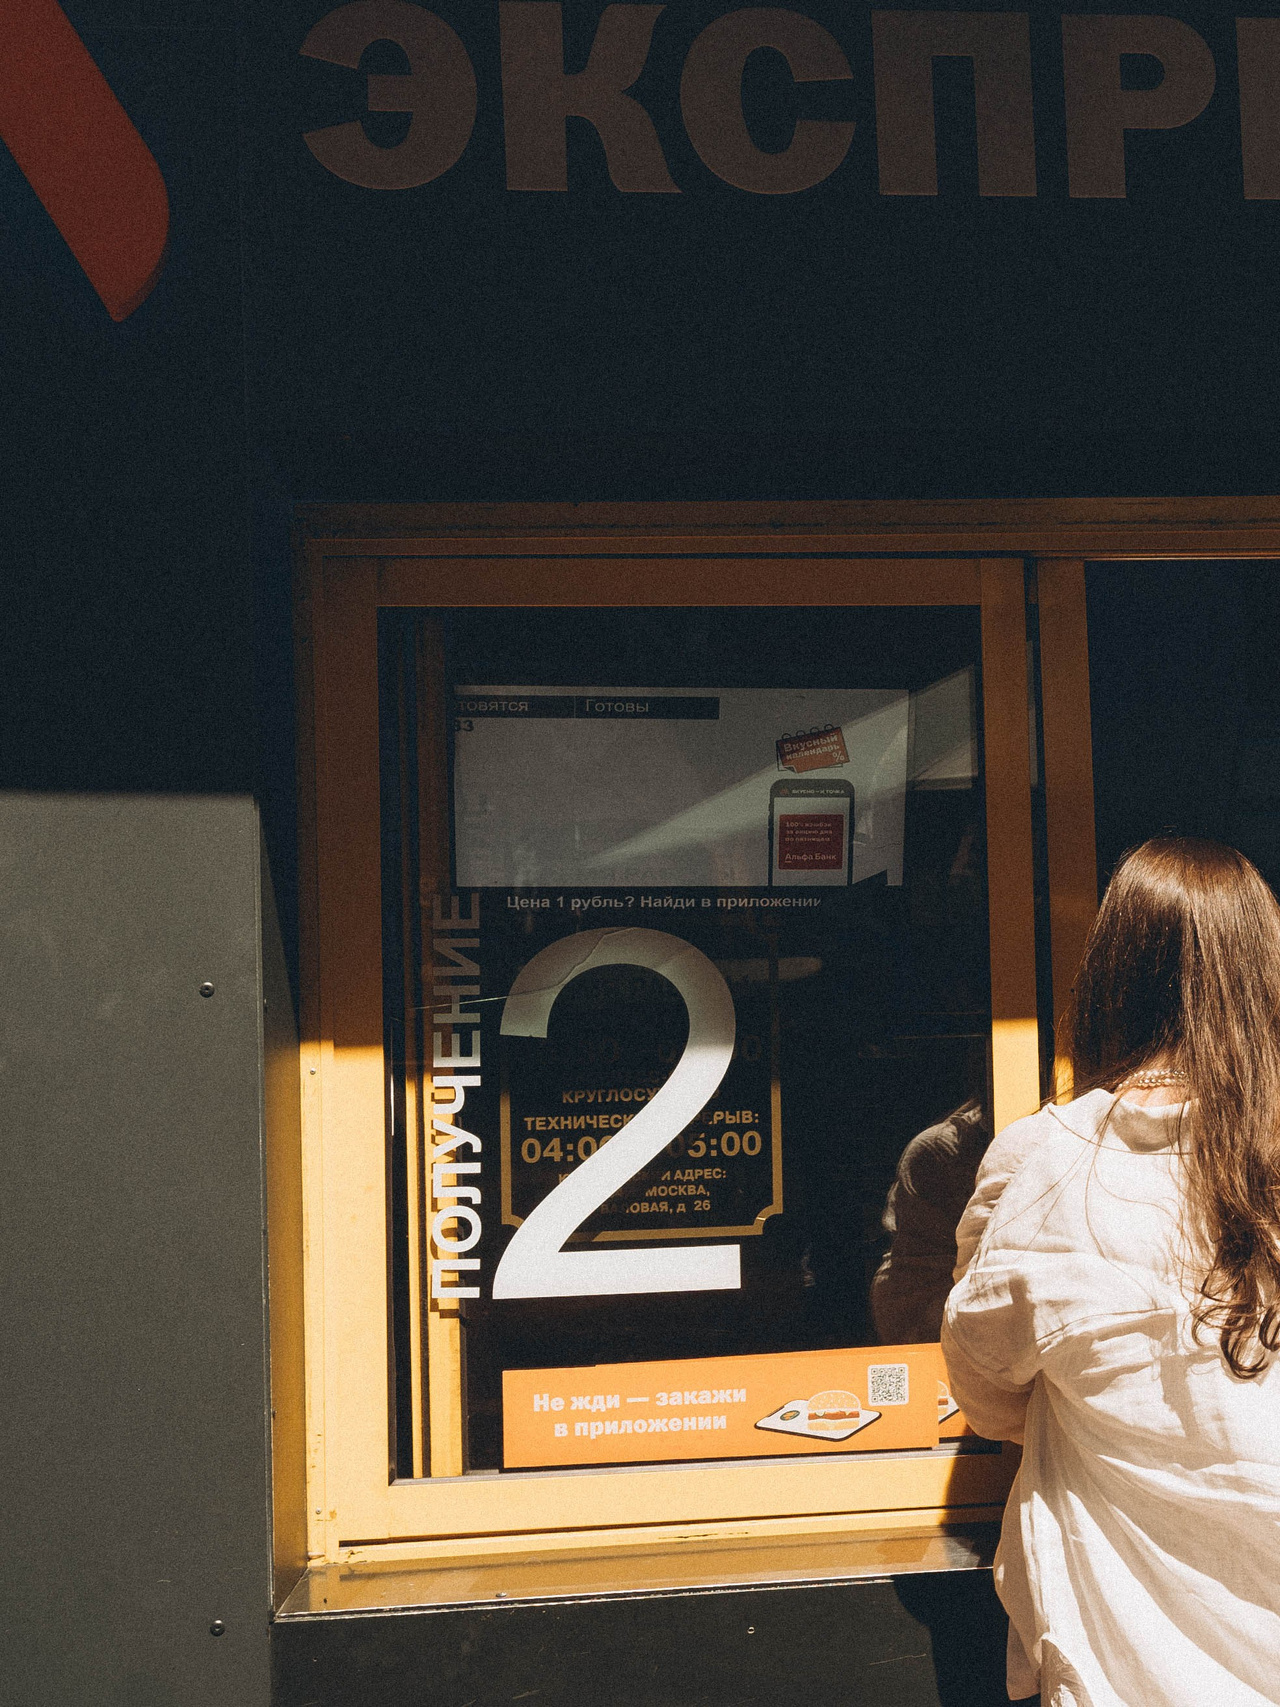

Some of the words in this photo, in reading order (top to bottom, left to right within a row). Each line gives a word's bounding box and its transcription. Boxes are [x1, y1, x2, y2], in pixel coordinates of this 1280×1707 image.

[457, 699, 528, 712] товятся
[585, 700, 649, 713] Готовы
[454, 720, 474, 732] 3
[783, 733, 838, 752] Вкусный
[786, 744, 840, 760] календарь
[785, 852, 813, 863] Альфа
[815, 852, 836, 860] Банк
[507, 896, 550, 909] Цена
[558, 897, 564, 907] 1
[571, 896, 634, 910] рубль?
[641, 896, 695, 909] Найди
[702, 899, 710, 907] в
[432, 892, 482, 1299] ПОЛУЧЕНИЕ
[493, 927, 741, 1300] 2
[524, 1114, 635, 1131] ТЕХНИЧЕСК
[674, 1168, 727, 1182] АДРЕС:
[693, 1200, 711, 1211] 26
[534, 1393, 564, 1412] Не
[569, 1394, 621, 1415] жди
[655, 1386, 746, 1407] закажи
[554, 1421, 568, 1437] в
[574, 1414, 727, 1440] приложении
